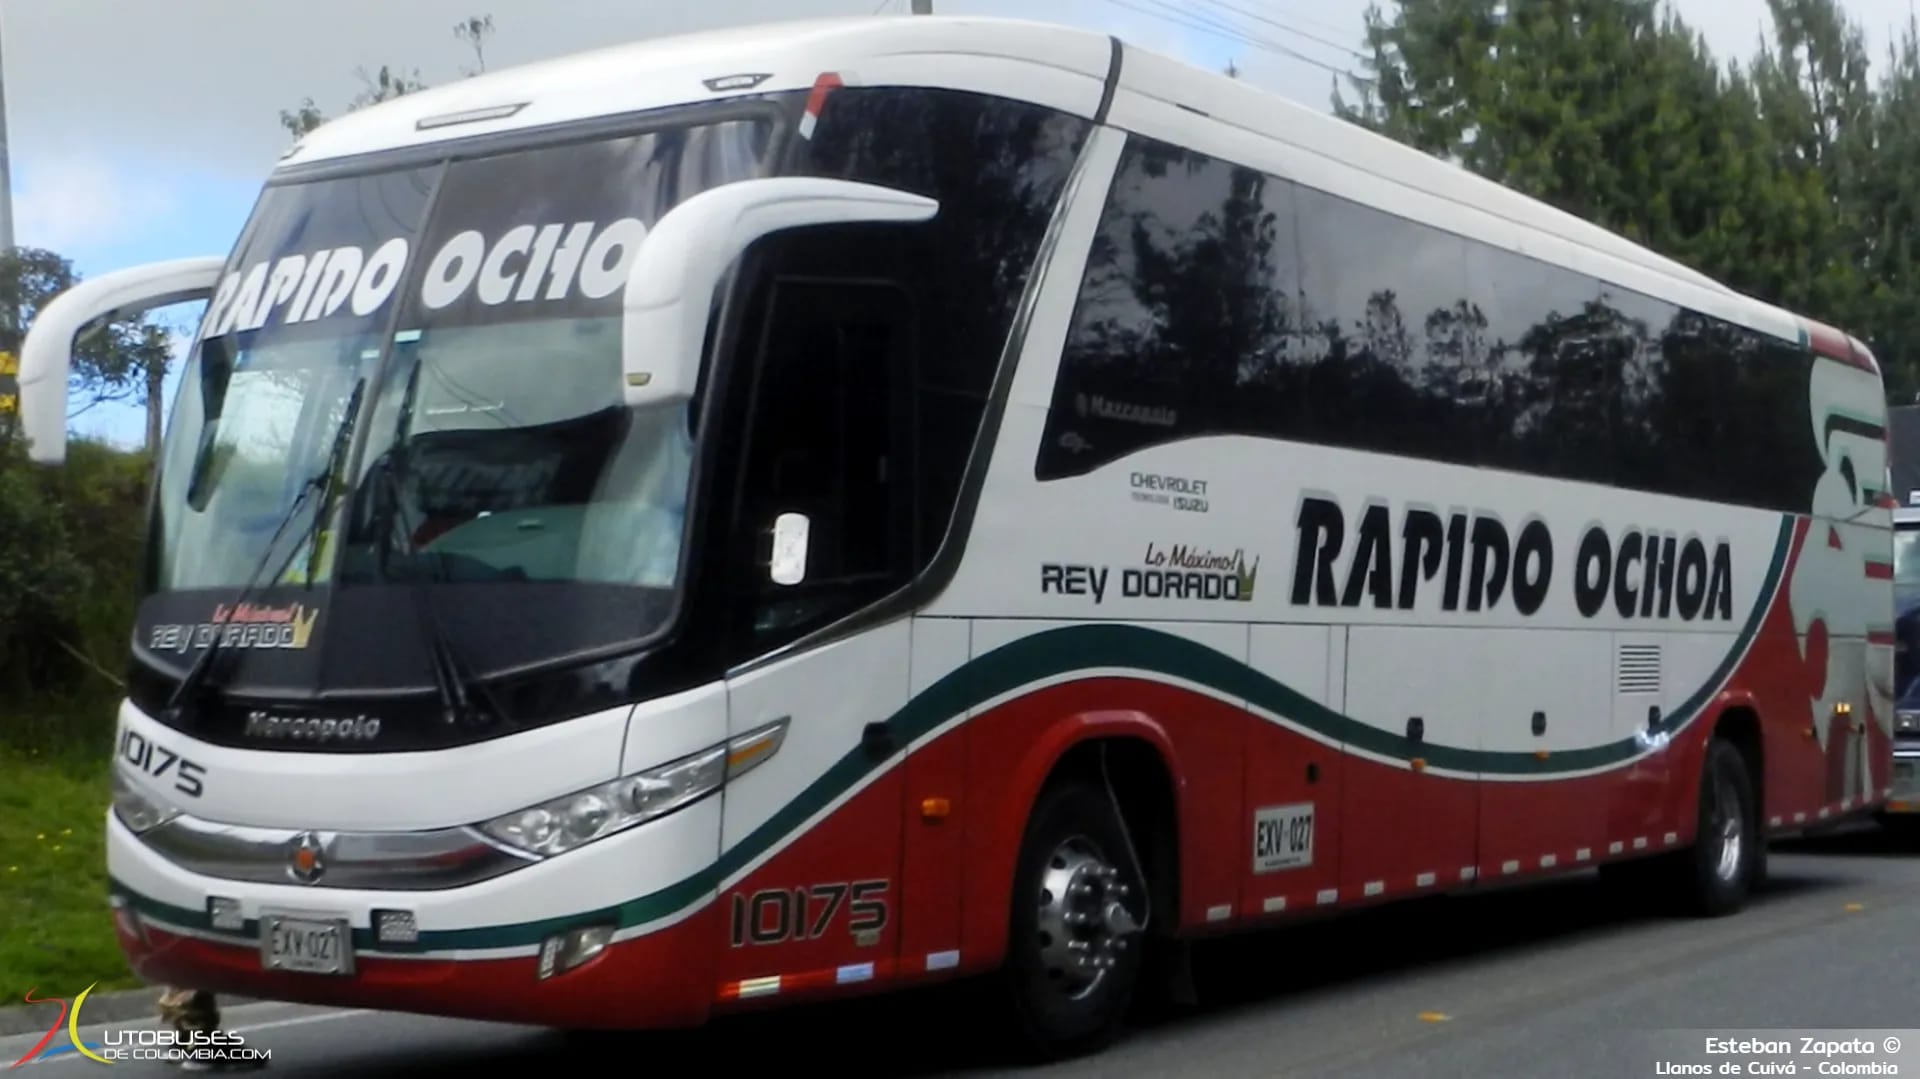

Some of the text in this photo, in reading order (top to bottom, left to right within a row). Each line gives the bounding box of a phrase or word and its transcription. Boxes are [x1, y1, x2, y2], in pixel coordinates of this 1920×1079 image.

[203, 217, 648, 339] RAPIDO OCHO
[1130, 471, 1208, 495] CHEVROLET
[1173, 497, 1209, 513] ISUZU
[1041, 564, 1240, 604] REY DORADO
[1144, 542, 1239, 571] Lo Máximo!
[1290, 493, 1734, 622] RAPIDO OCHOA
[120, 728, 207, 799] 10175
[731, 878, 890, 948] 10175
